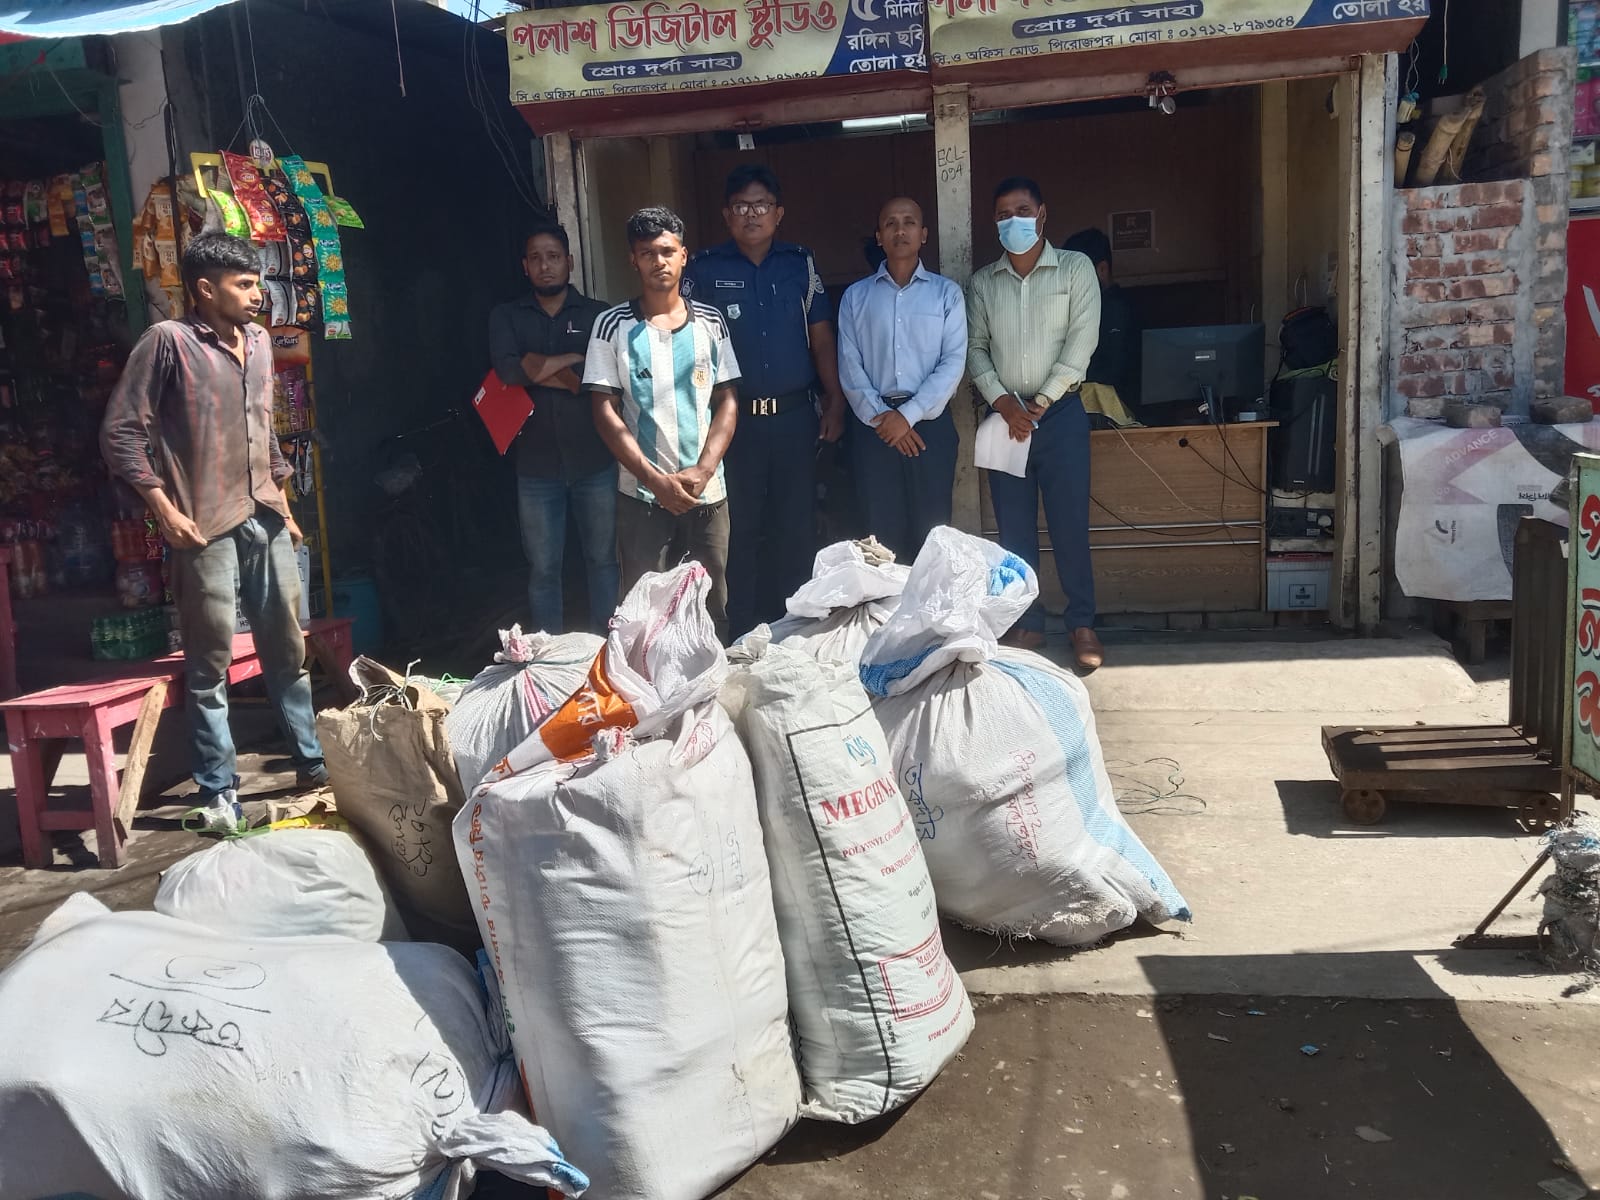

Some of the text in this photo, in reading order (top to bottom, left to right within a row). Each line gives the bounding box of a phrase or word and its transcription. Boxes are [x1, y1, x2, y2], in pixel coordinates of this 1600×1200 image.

[1140, 3, 1198, 20] সাহা
[1332, 0, 1391, 20] তোলা
[513, 18, 597, 55] পলাশ
[607, 2, 737, 52] ডিজিটাল
[965, 46, 1004, 60] অফিস
[1048, 34, 1114, 53] পিরোজপুর
[1128, 30, 1163, 44] মোবা
[1178, 15, 1295, 37] ০১৭১২-৮৭৯৩৫৪
[688, 55, 738, 70] সাহা
[850, 53, 927, 73] তোলা হয়
[1444, 428, 1498, 465] ADVANCE
[819, 776, 896, 825] MEGHNA
